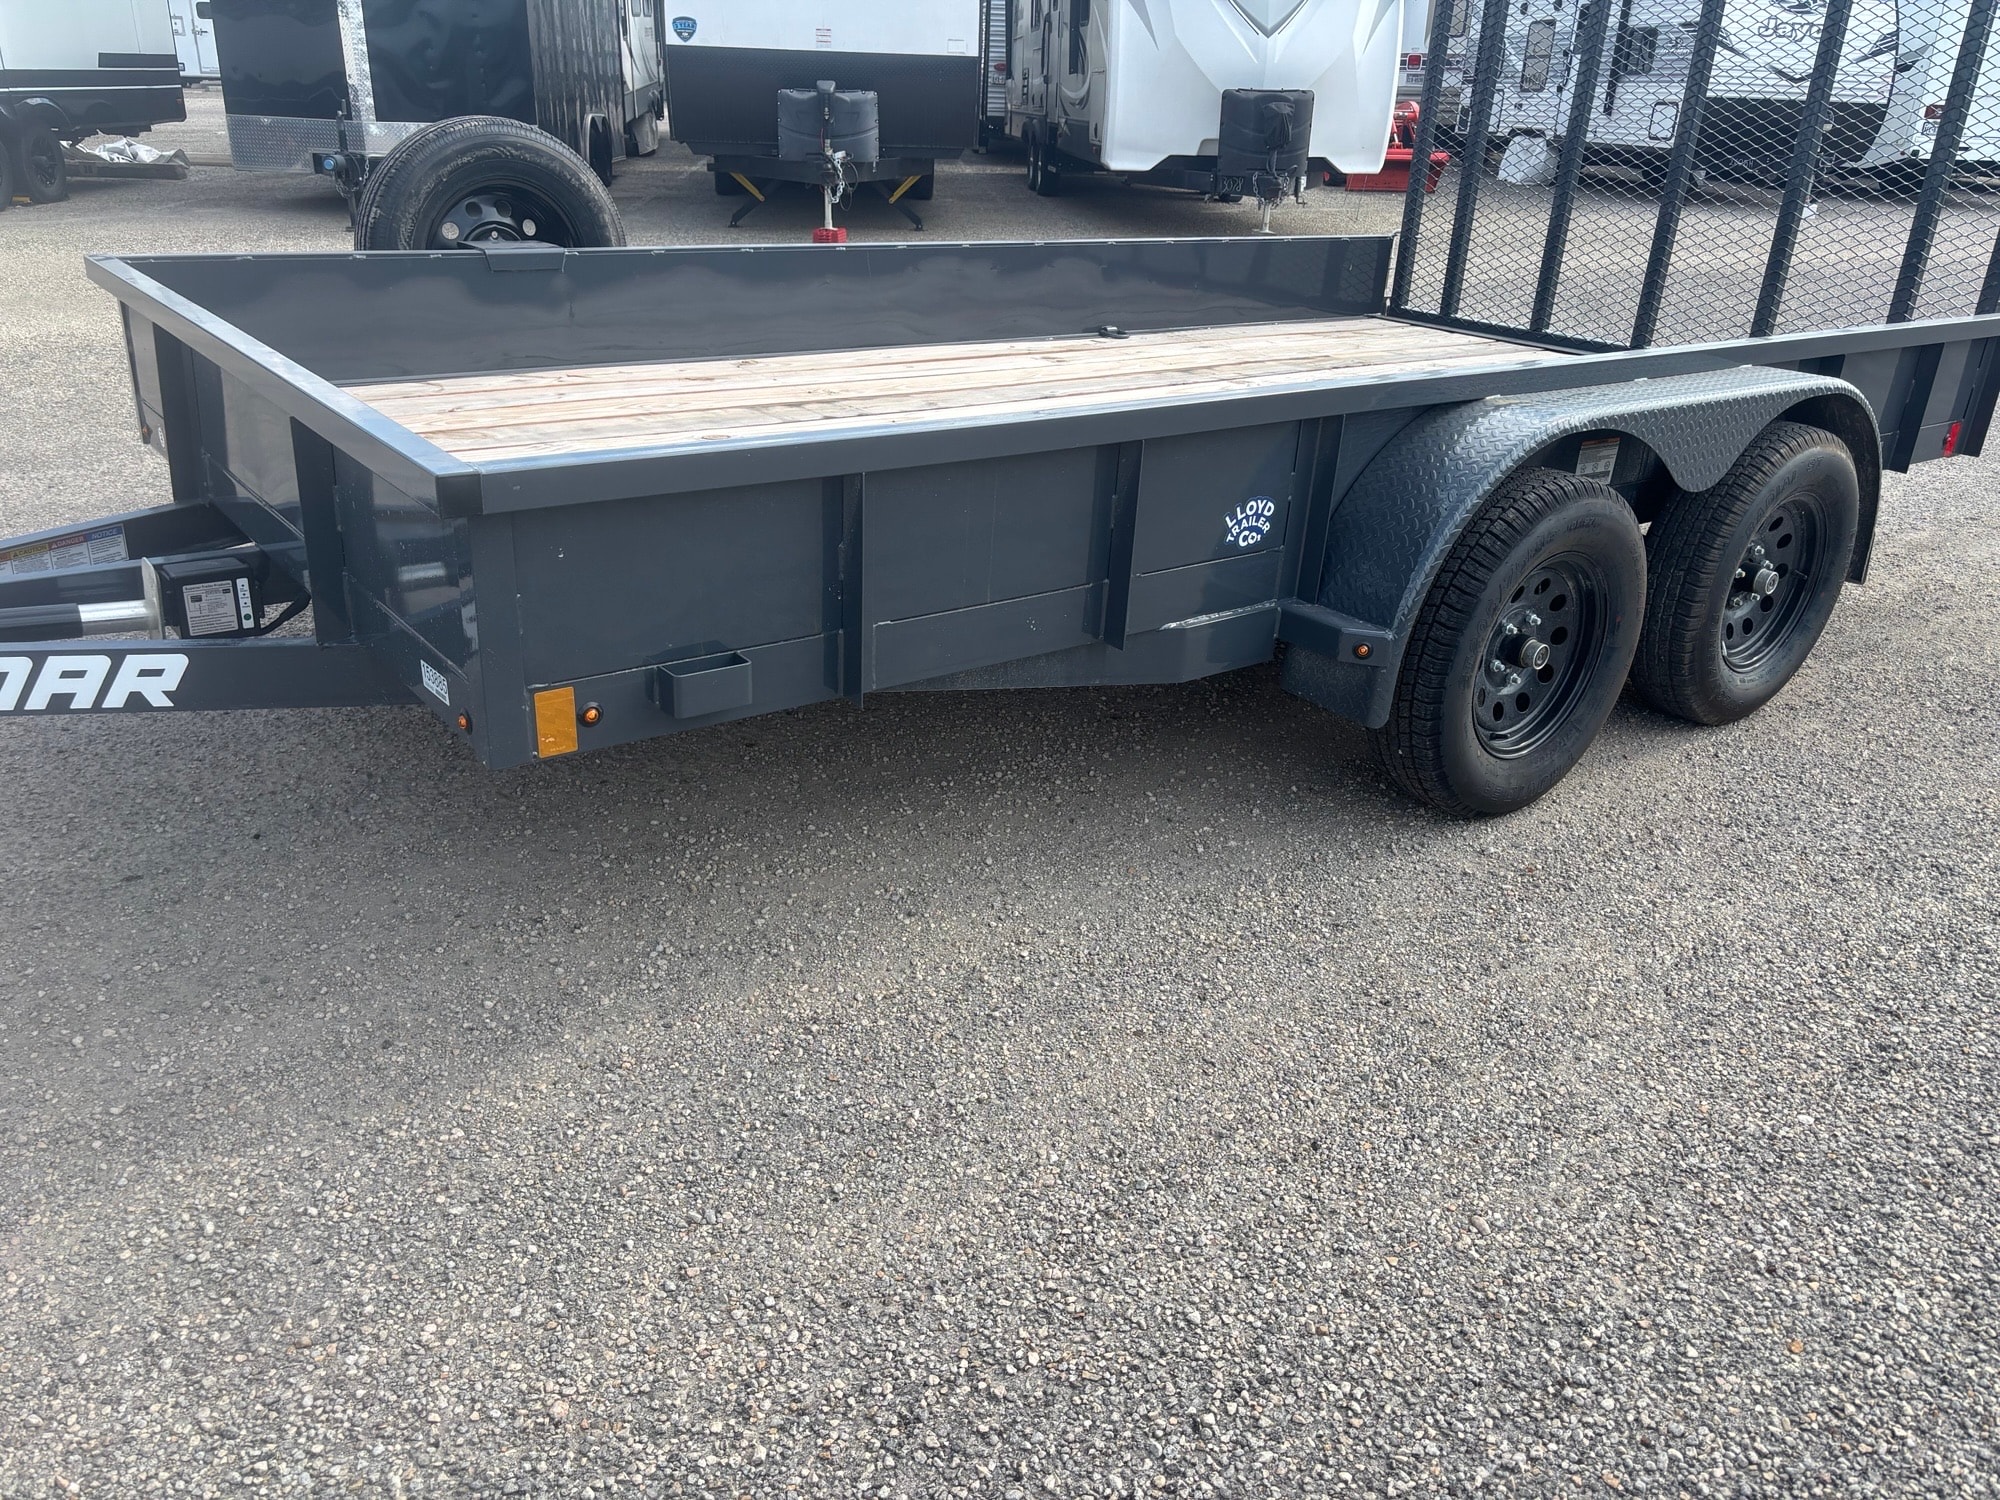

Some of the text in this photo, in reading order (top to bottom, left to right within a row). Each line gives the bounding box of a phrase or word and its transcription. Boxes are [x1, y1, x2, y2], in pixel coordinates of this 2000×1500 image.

[1758, 16, 1824, 42] Jayc
[1225, 499, 1275, 528] LLOYD
[91, 527, 118, 540] NOTICE
[1226, 515, 1271, 542] TRAILER
[20, 544, 48, 557] CAUTION
[57, 535, 85, 548] DANGER
